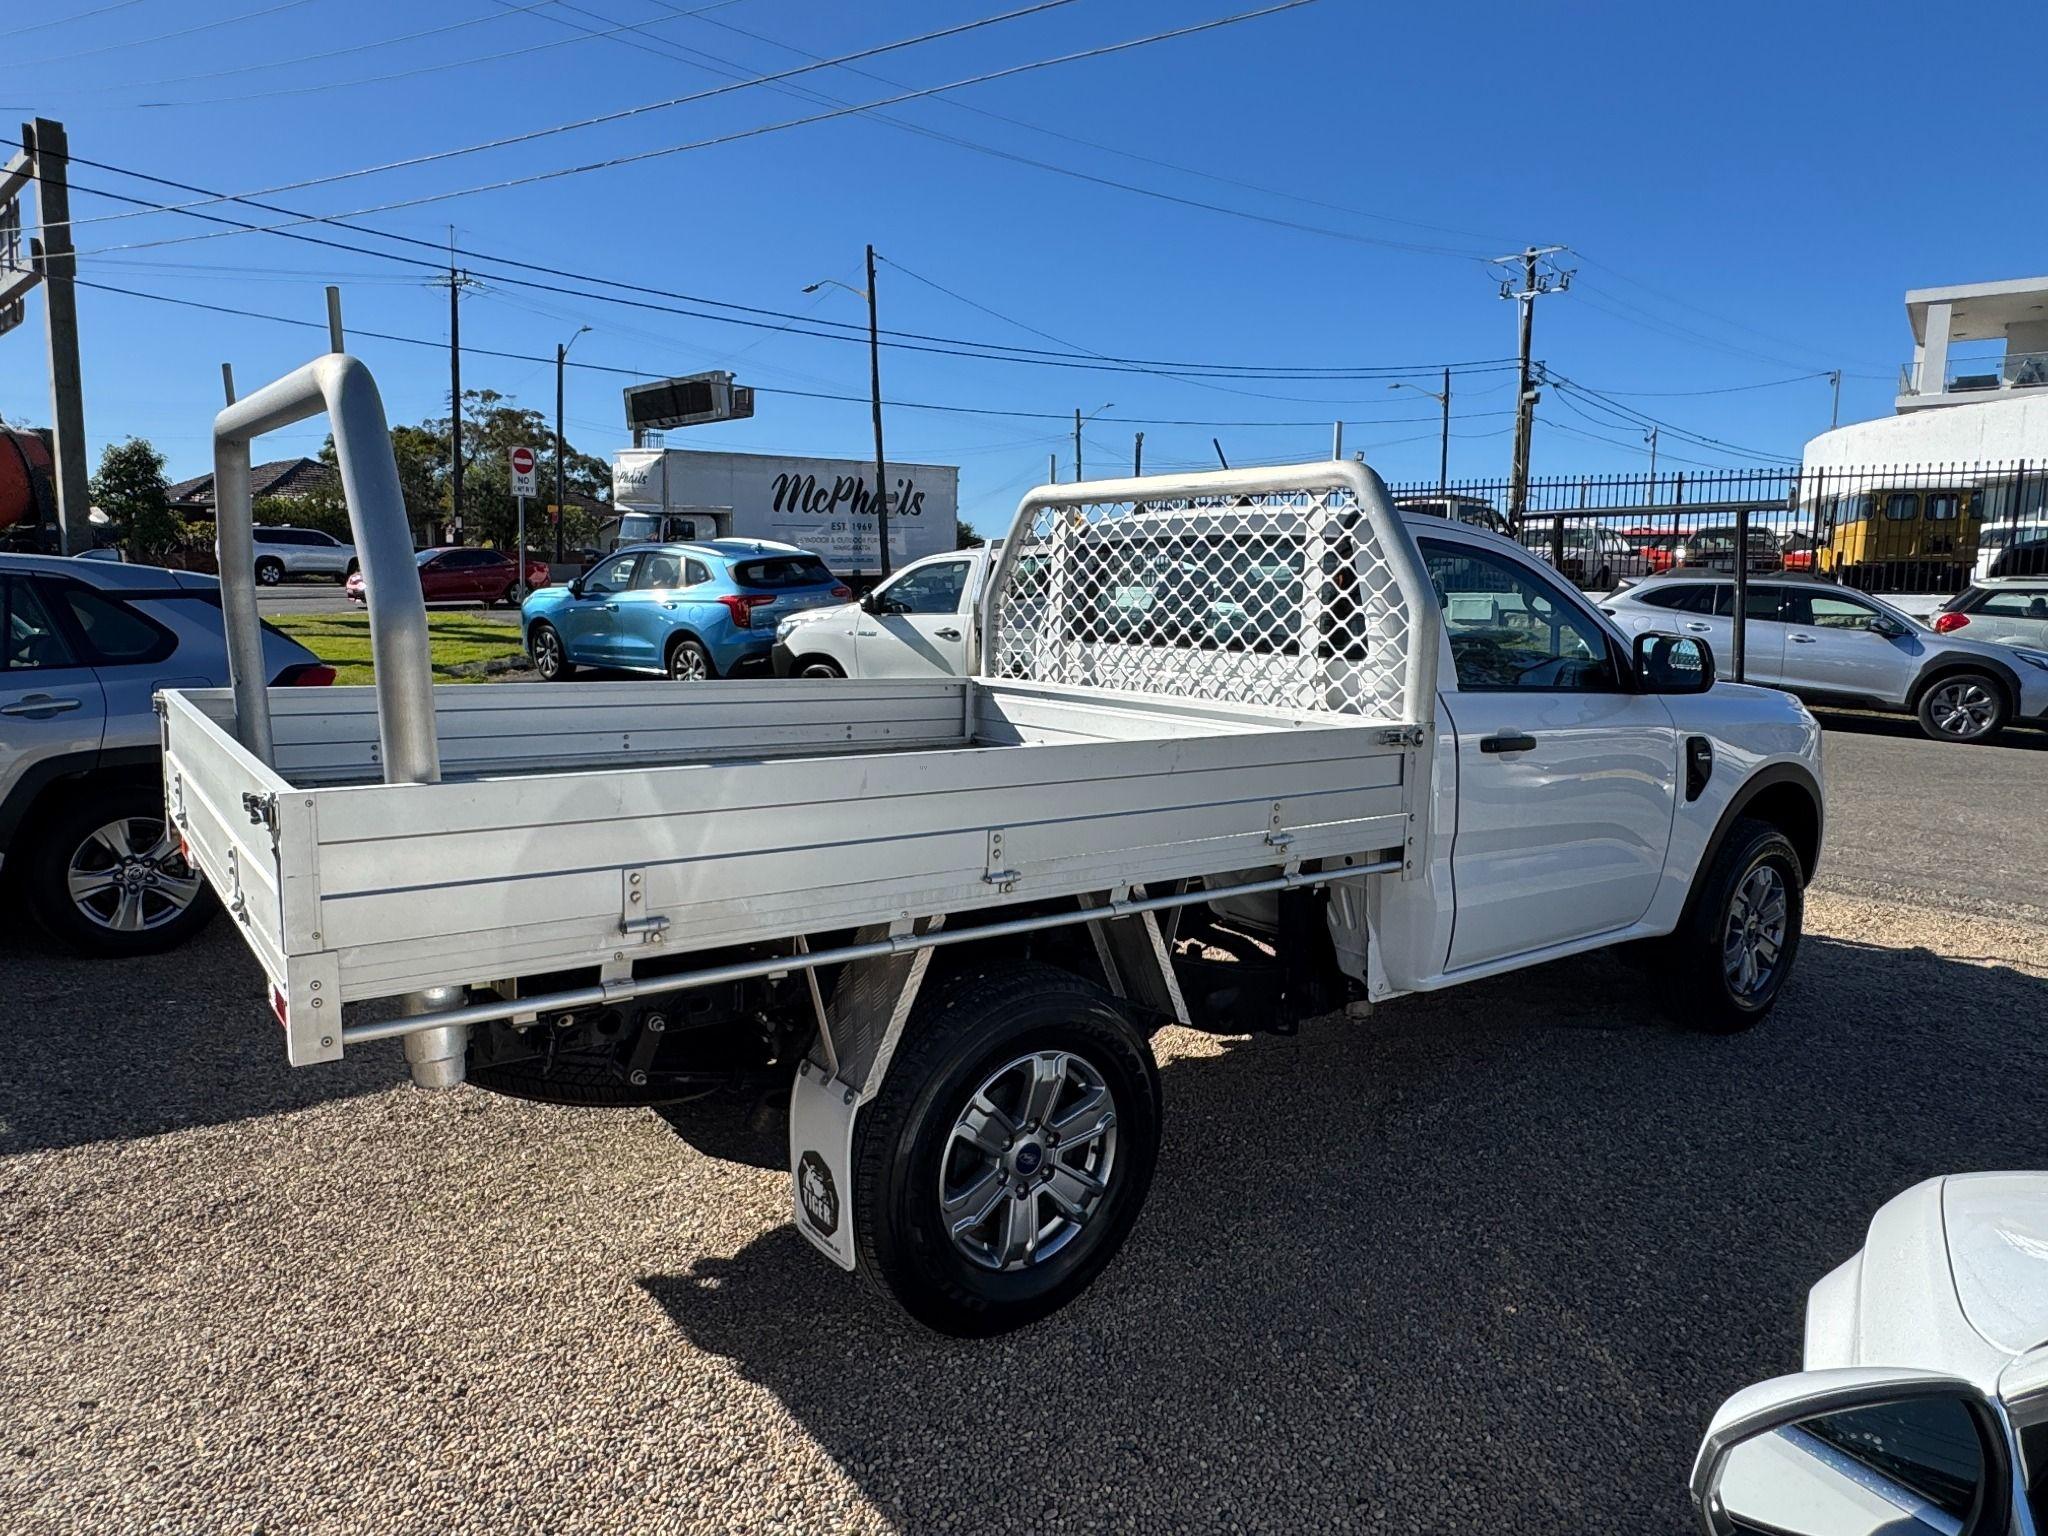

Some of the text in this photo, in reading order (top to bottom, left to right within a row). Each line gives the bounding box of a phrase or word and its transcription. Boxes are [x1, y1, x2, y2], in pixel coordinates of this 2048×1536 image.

[517, 476, 530, 485] NO
[513, 485, 535, 493] ENTRY
[852, 523, 873, 532] 1969
